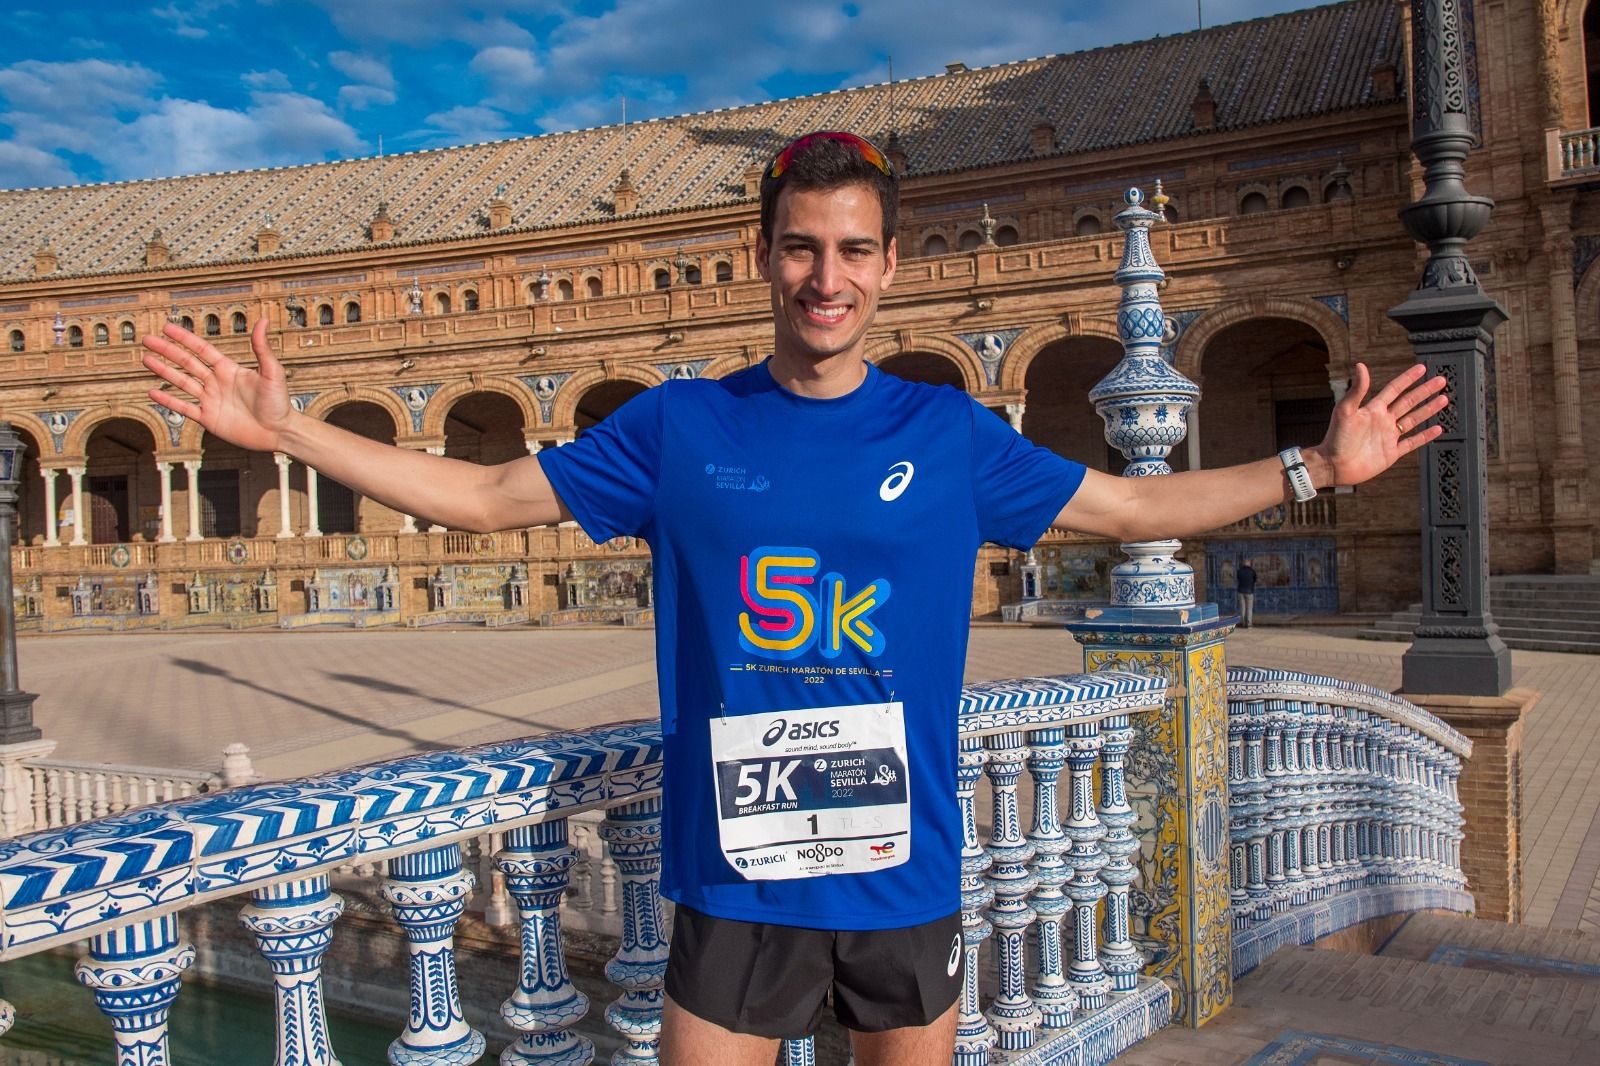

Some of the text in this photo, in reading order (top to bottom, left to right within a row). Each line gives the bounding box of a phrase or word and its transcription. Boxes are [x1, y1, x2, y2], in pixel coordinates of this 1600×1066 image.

[745, 663, 757, 671] 5K
[758, 664, 789, 674] ZURICH
[835, 667, 847, 675] DE
[848, 667, 881, 677] SEVILLA
[804, 676, 825, 684] 2022
[819, 742, 837, 750] sound
[830, 758, 866, 769] ZURICH
[830, 768, 867, 779] MARATÓN
[734, 759, 802, 806] 5K
[830, 777, 868, 788] SEVILLA
[831, 788, 854, 798] 2022
[738, 801, 798, 815] BREAKFAST RUN
[806, 813, 818, 835] 1
[750, 853, 786, 867] ZURICH
